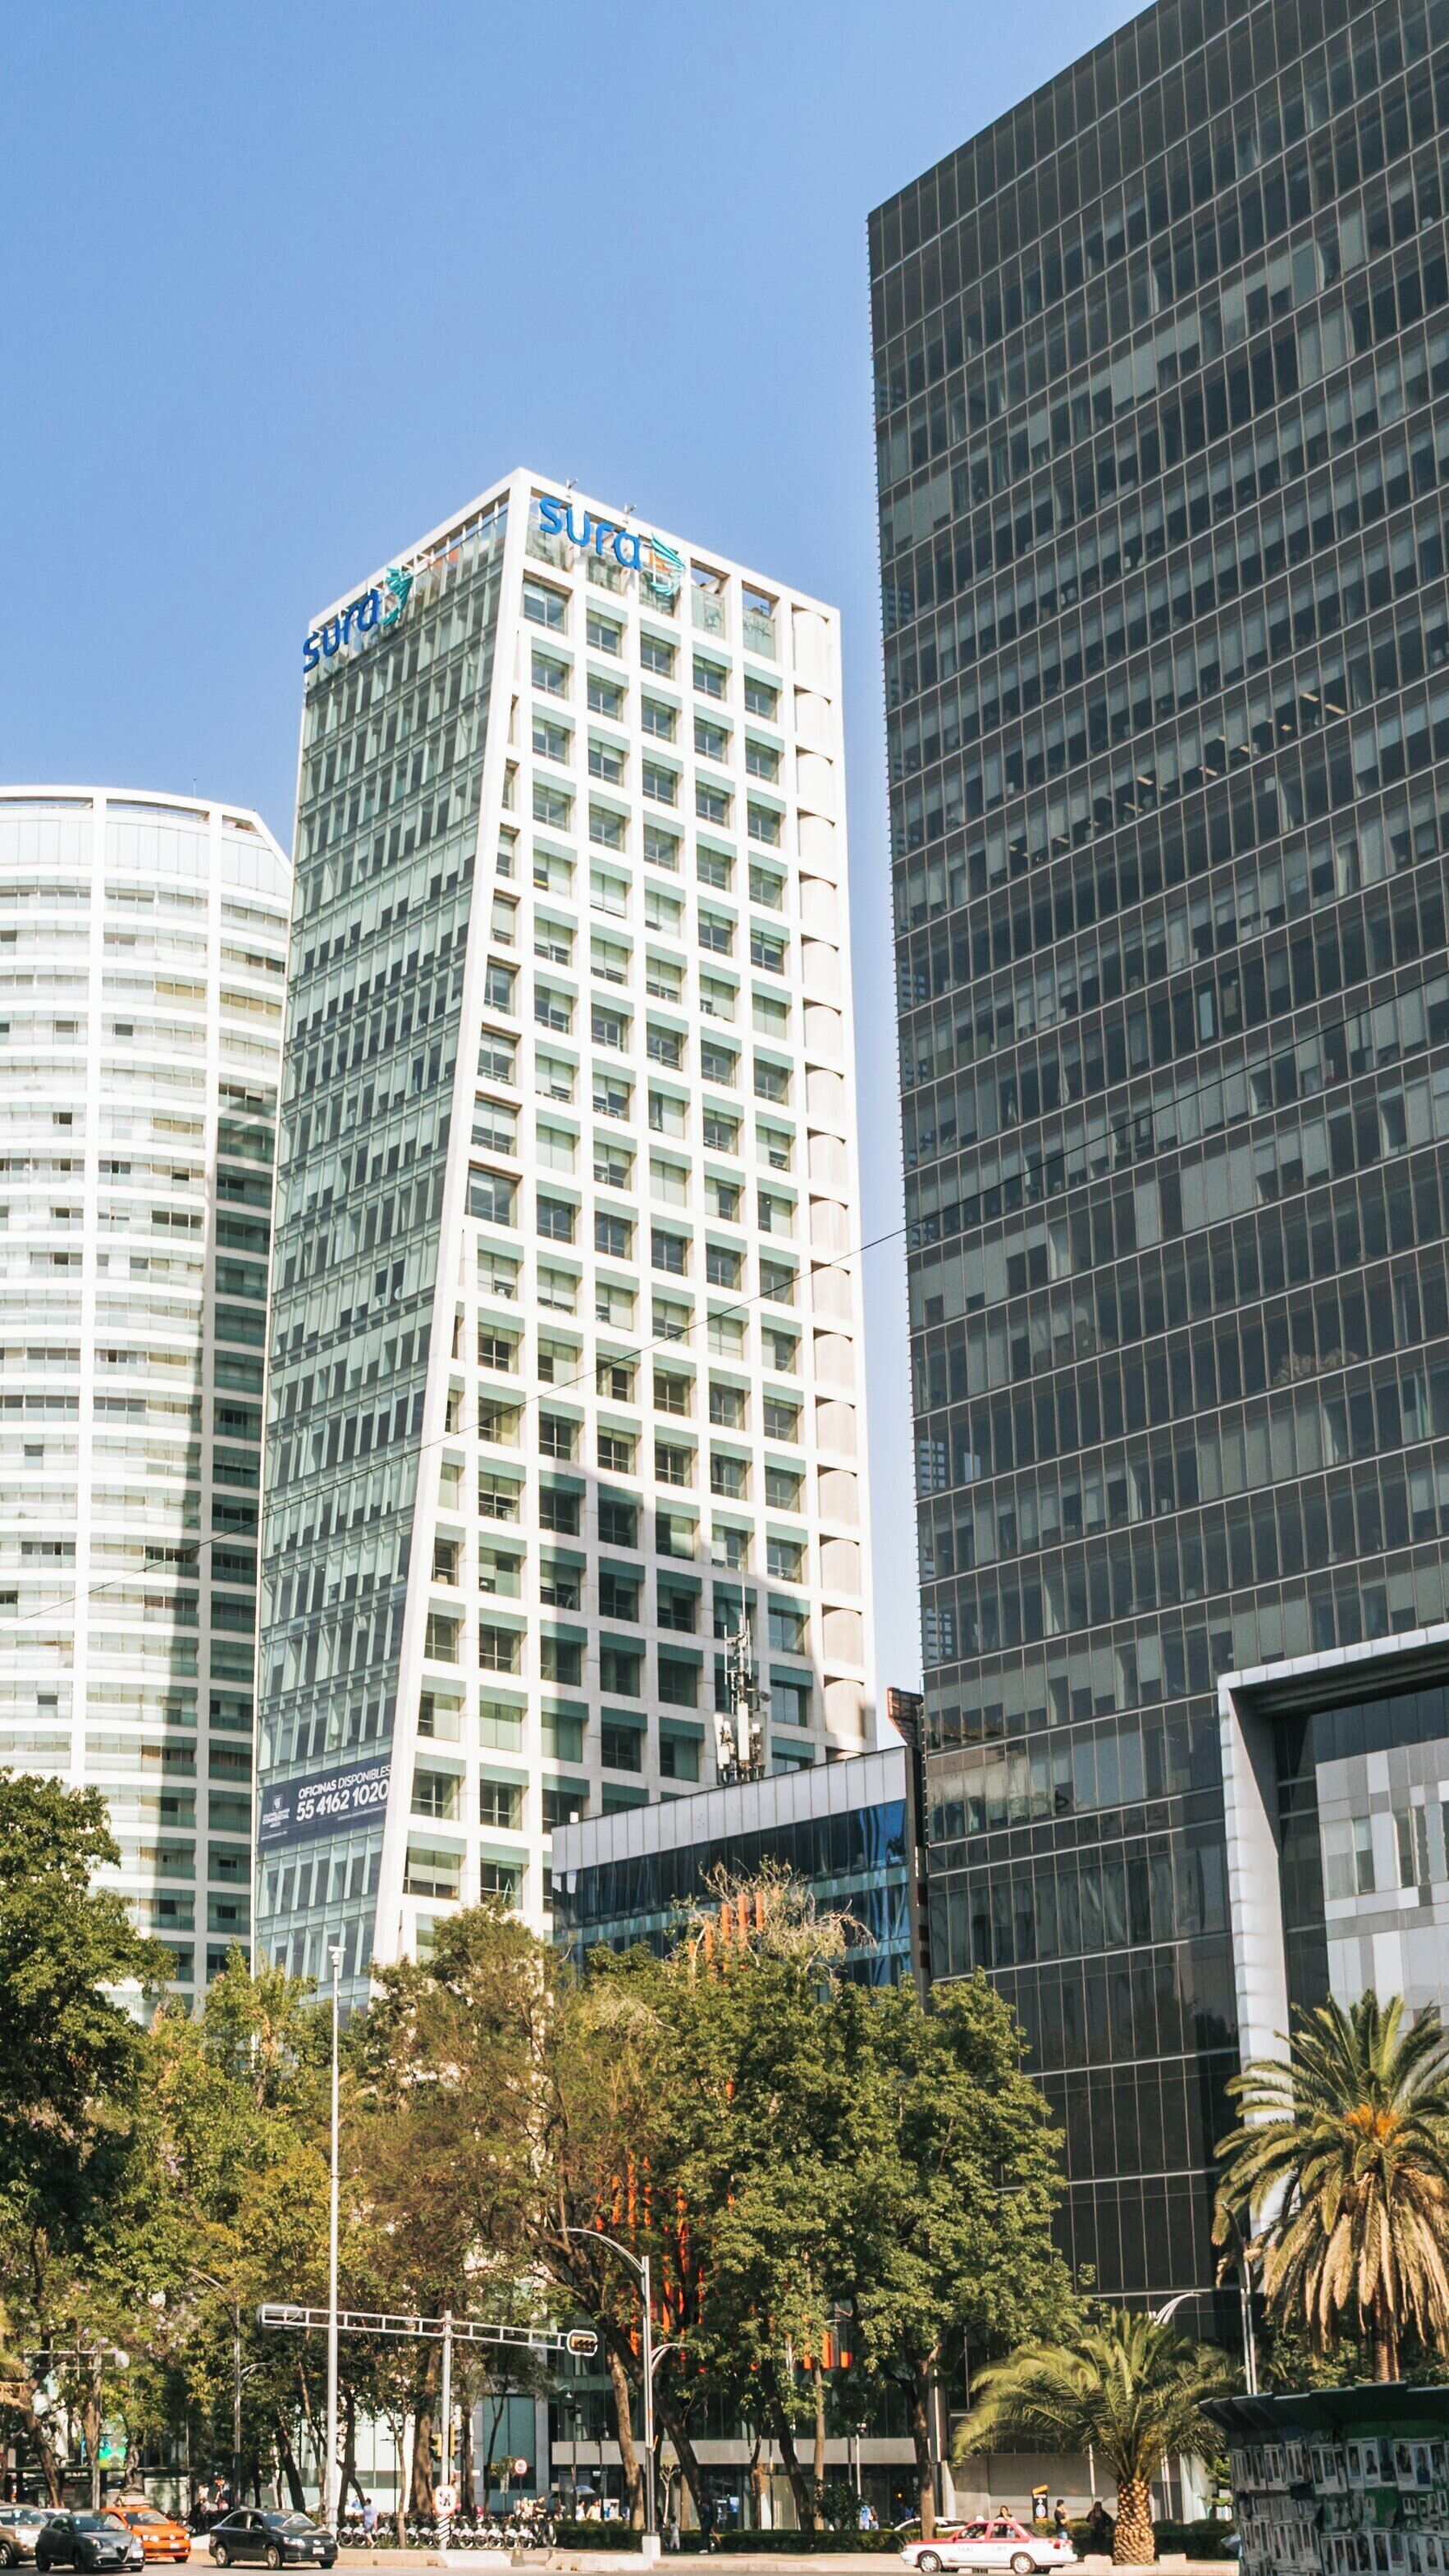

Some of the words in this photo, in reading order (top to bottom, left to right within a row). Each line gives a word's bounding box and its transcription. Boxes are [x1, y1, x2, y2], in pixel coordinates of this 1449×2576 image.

[539, 496, 642, 571] sura
[303, 589, 380, 674] sura
[295, 1798, 315, 1822] 55
[315, 1789, 350, 1816] 4162
[352, 1779, 391, 1807] 1020
[298, 1779, 337, 1800] OFICINAS
[337, 1764, 391, 1789] DISPONIBLES
